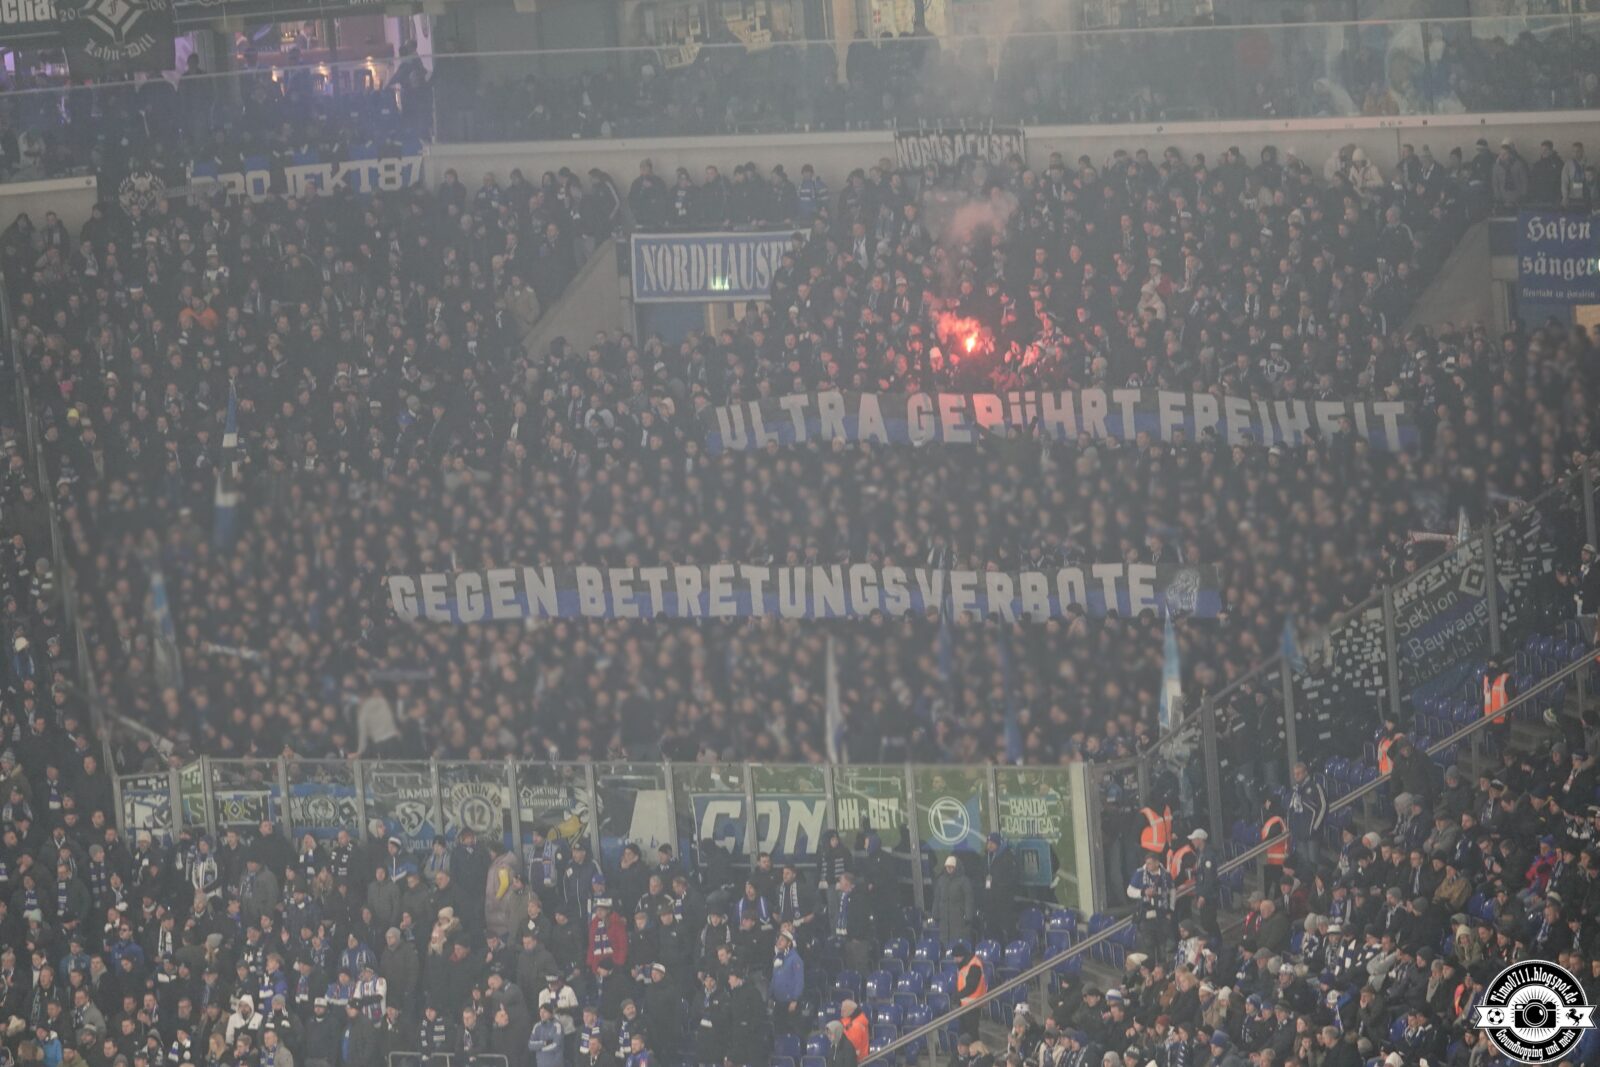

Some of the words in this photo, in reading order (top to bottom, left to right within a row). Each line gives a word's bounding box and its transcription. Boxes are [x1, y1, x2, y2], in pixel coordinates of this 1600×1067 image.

[1526, 216, 1591, 244] Hafen
[641, 240, 795, 292] NORDHAUSE
[715, 391, 889, 450] ULTRA
[1158, 390, 1405, 453] FREIHEIT
[388, 566, 558, 623] GEGEN
[576, 562, 1159, 624] BETRETUNGSVERBOTE
[1395, 591, 1458, 636] Sektion
[466, 804, 487, 825] 12
